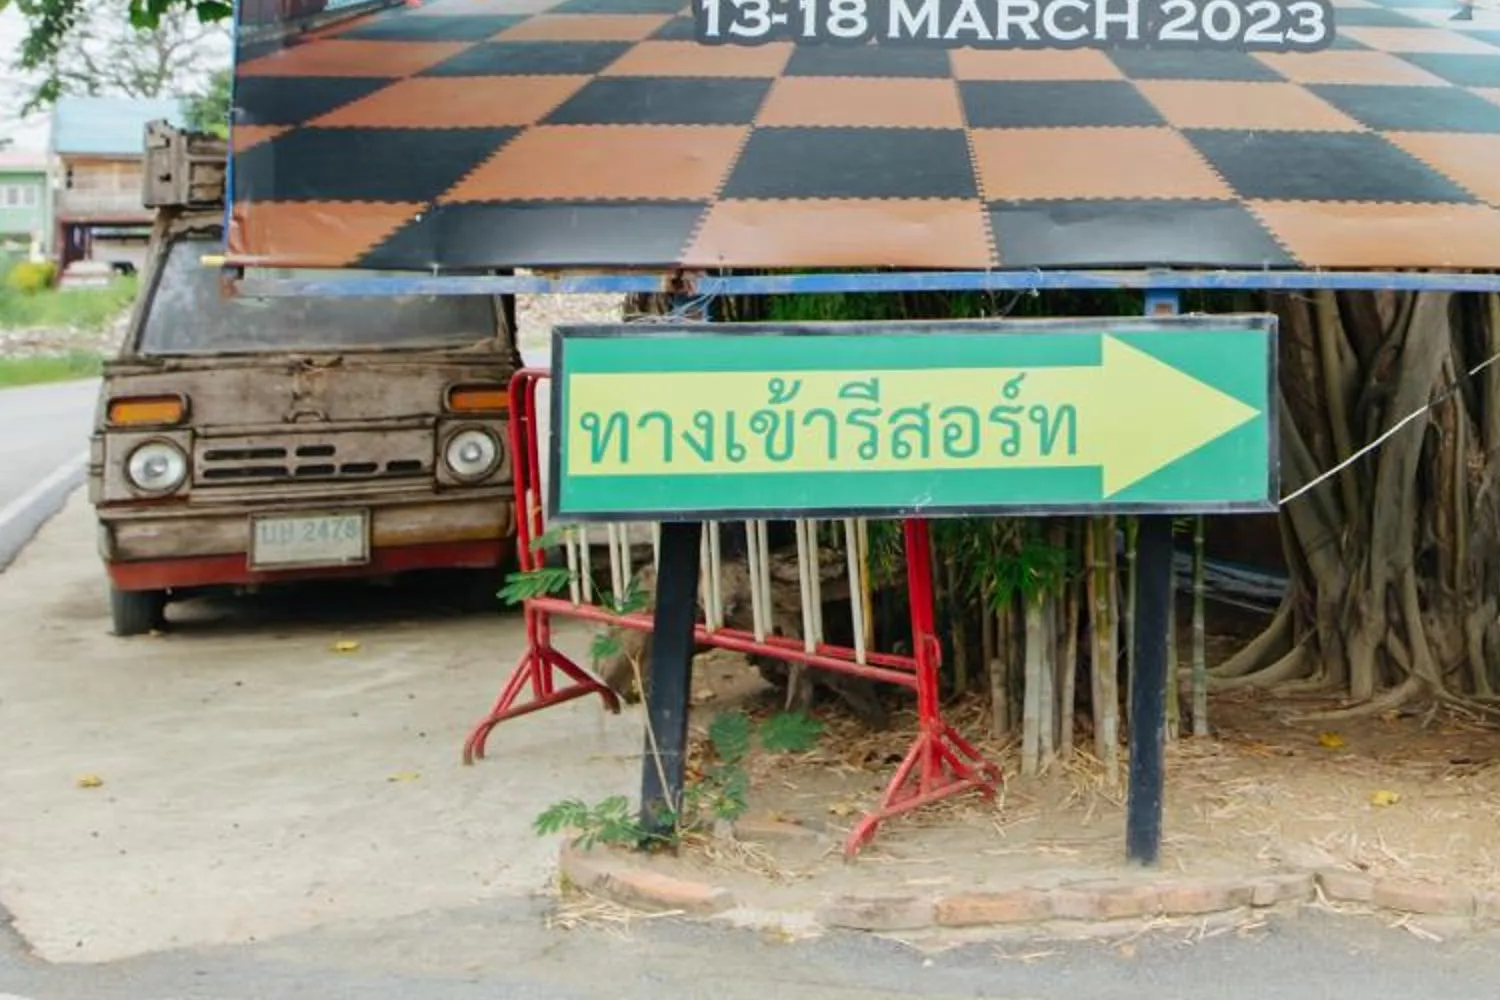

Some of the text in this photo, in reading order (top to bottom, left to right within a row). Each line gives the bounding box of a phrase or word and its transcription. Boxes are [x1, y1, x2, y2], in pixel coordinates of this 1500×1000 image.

[579, 372, 1078, 465] ทางเข้ารีสอร์ท
